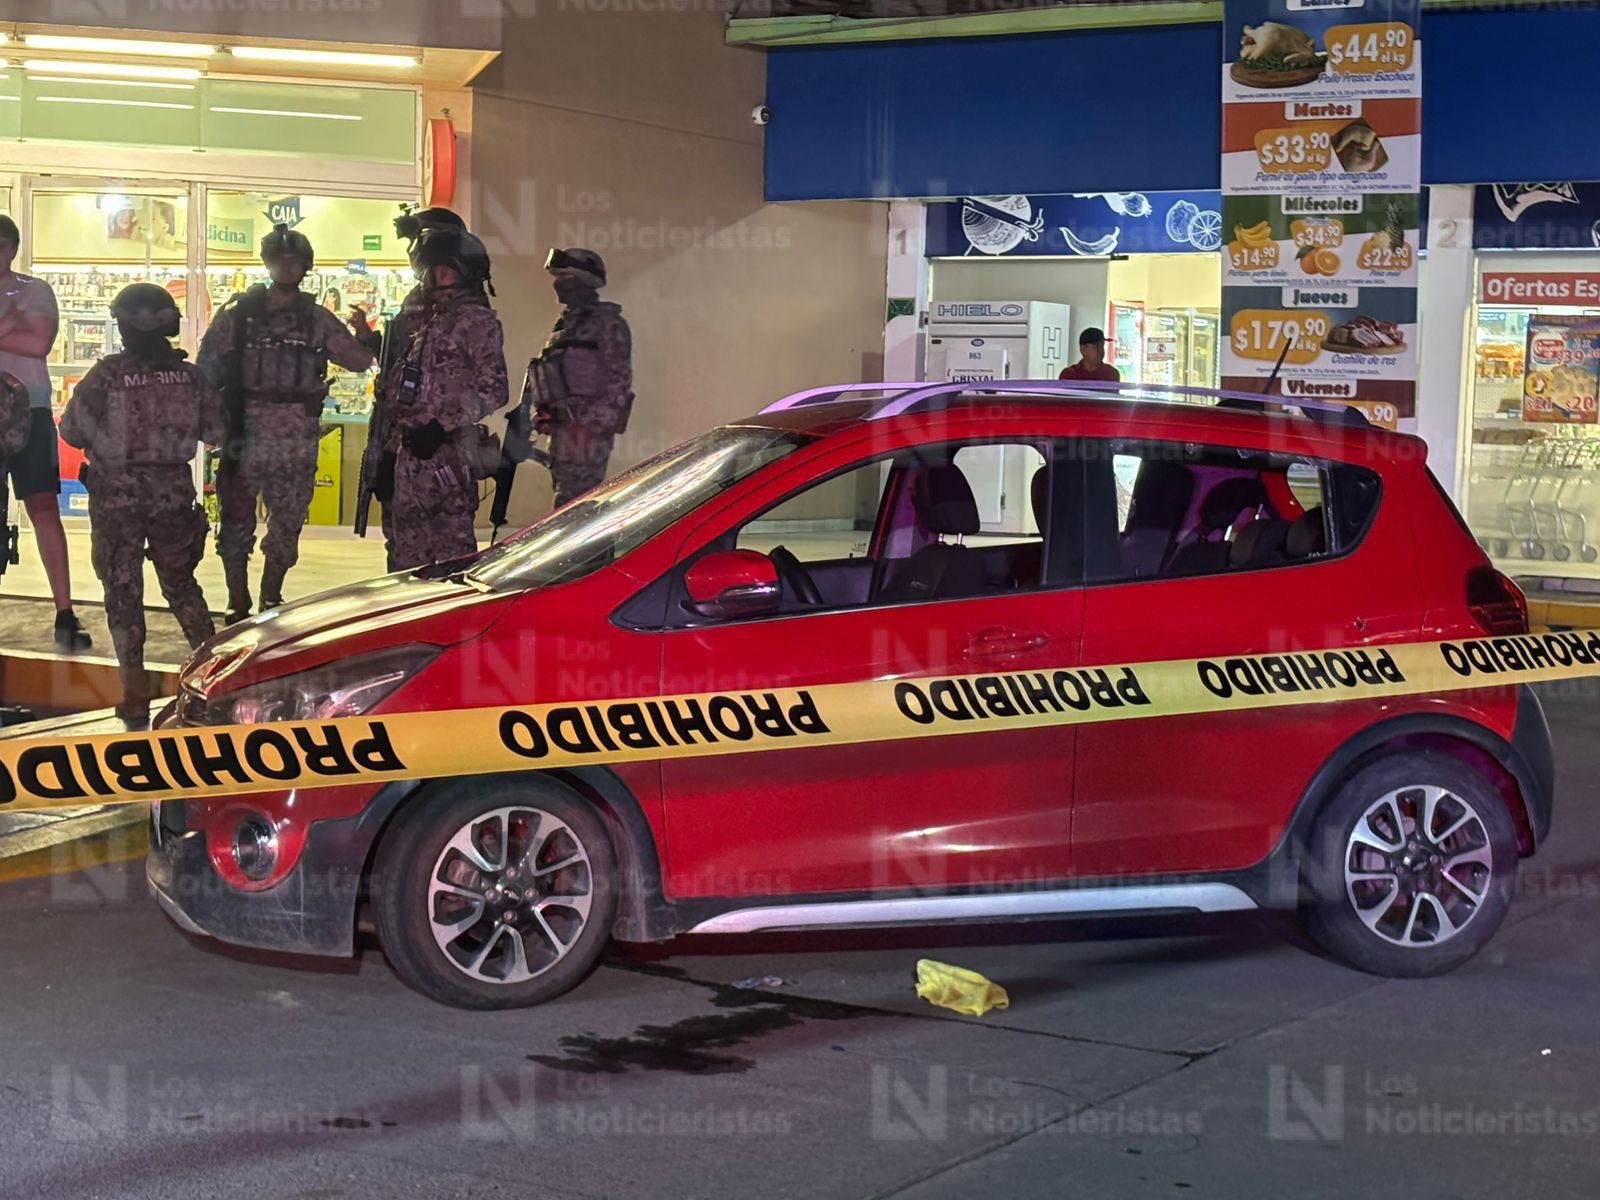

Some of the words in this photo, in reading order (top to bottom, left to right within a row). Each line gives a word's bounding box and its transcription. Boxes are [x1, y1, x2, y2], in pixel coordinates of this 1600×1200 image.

[1294, 103, 1353, 117] Martes
[271, 204, 297, 222] CAJA
[1285, 196, 1359, 212] Miércoles
[207, 224, 246, 244] dicina
[1437, 220, 1457, 248] 2
[1293, 289, 1348, 305] Jueves
[1487, 277, 1570, 300] Ofertas
[938, 304, 1023, 316] HIELO
[1236, 318, 1326, 351] $179.90
[1287, 380, 1351, 395] Viernes
[1197, 648, 1406, 698] PROHIBIDO
[894, 667, 1152, 724] PROHIBIDO
[499, 691, 831, 758] PROHIBIDO
